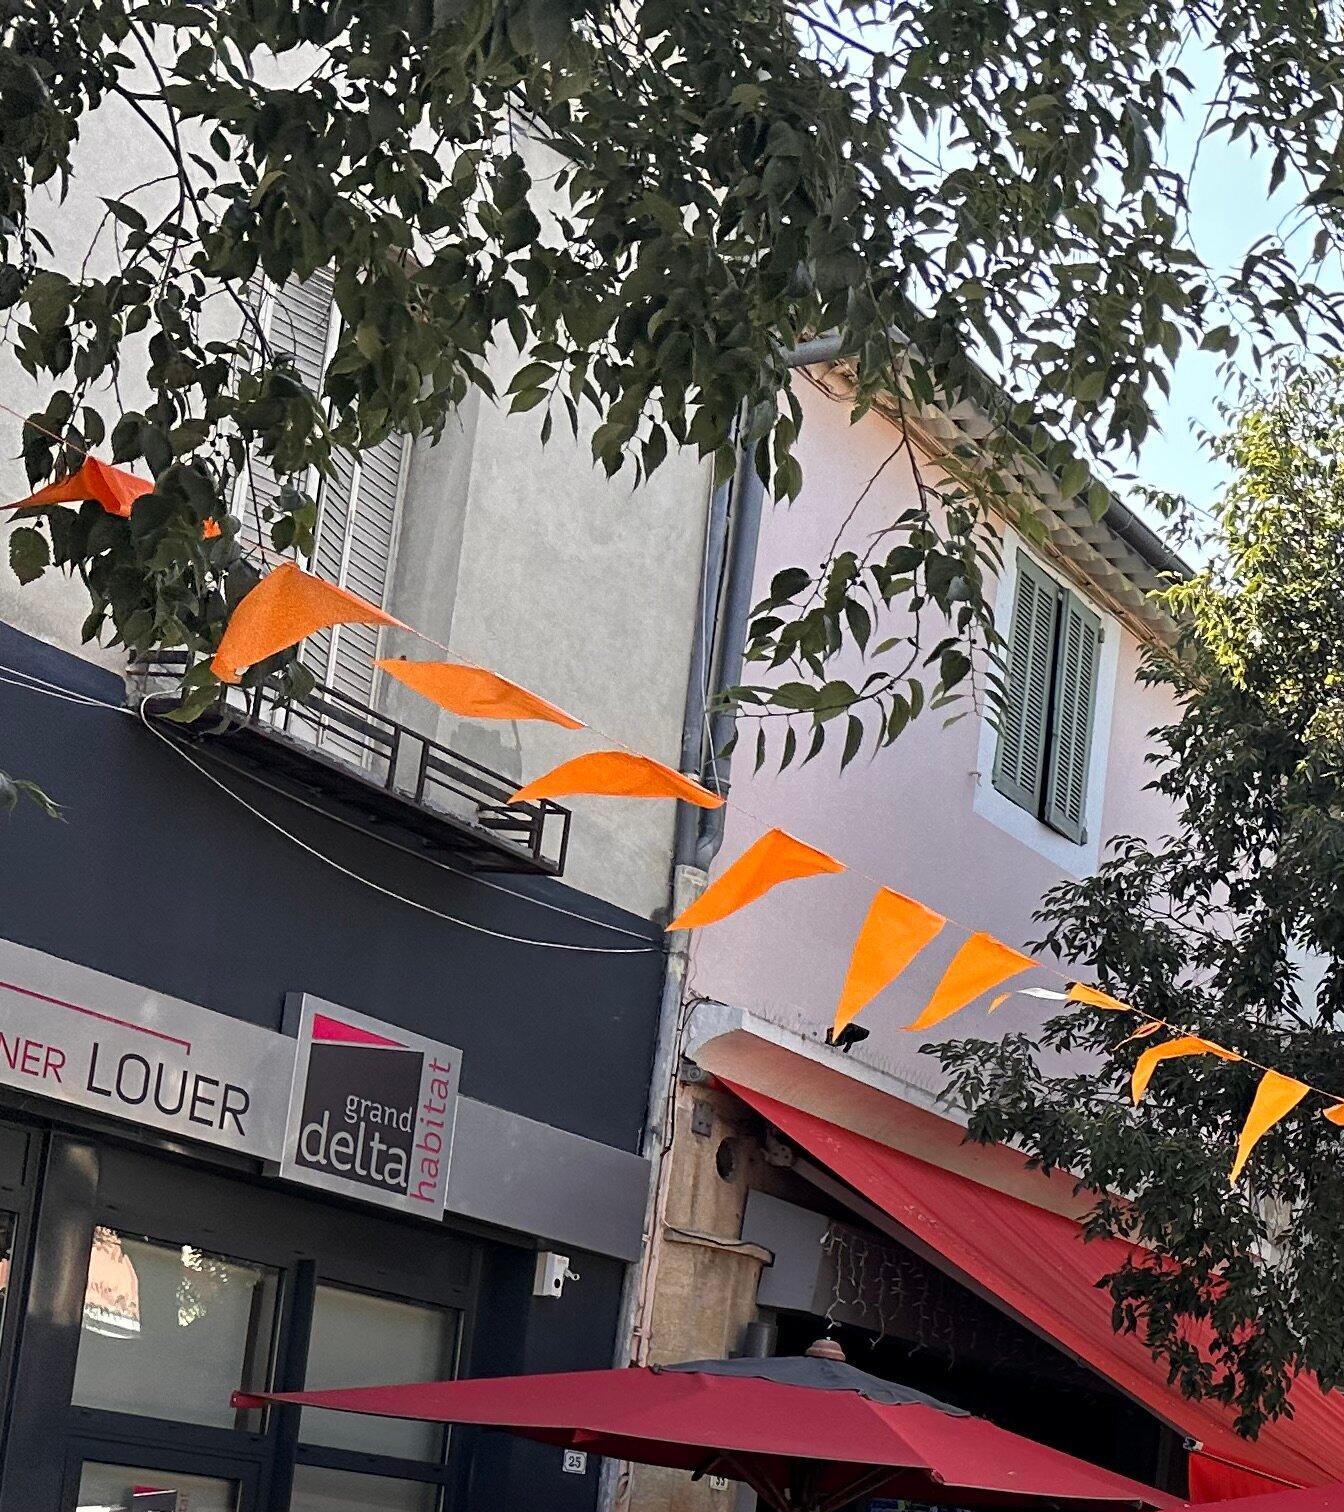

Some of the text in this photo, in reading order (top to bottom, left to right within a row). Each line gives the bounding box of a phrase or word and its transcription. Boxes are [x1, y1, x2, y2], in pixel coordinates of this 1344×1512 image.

[87, 1042, 250, 1136] LOUER
[344, 1095, 413, 1133] grand
[300, 1110, 407, 1188] delta
[410, 1058, 452, 1204] habitat
[569, 1456, 581, 1469] 25
